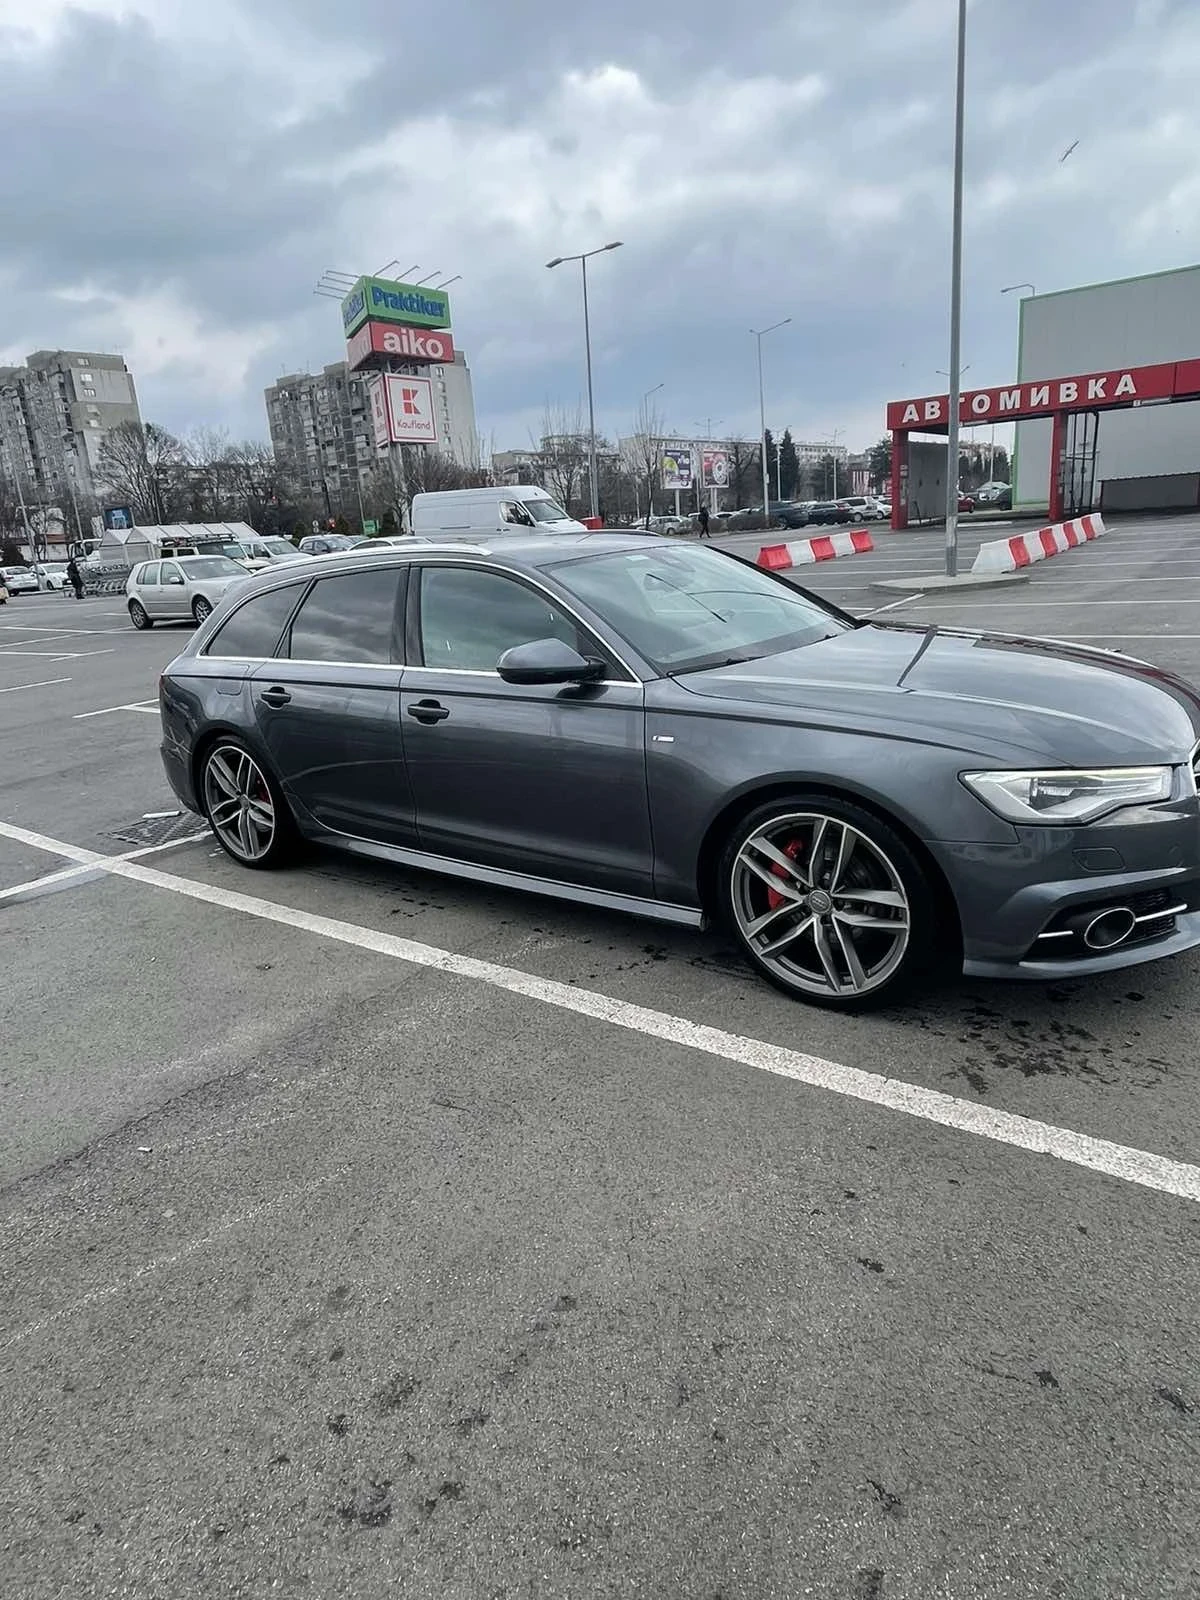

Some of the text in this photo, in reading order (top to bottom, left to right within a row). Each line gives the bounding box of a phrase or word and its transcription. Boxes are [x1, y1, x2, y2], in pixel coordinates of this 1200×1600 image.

[372, 286, 445, 318] Praktiker
[383, 328, 444, 359] aiko
[902, 375, 1136, 423] АВОМИВКА
[397, 419, 431, 430] Kaufland
